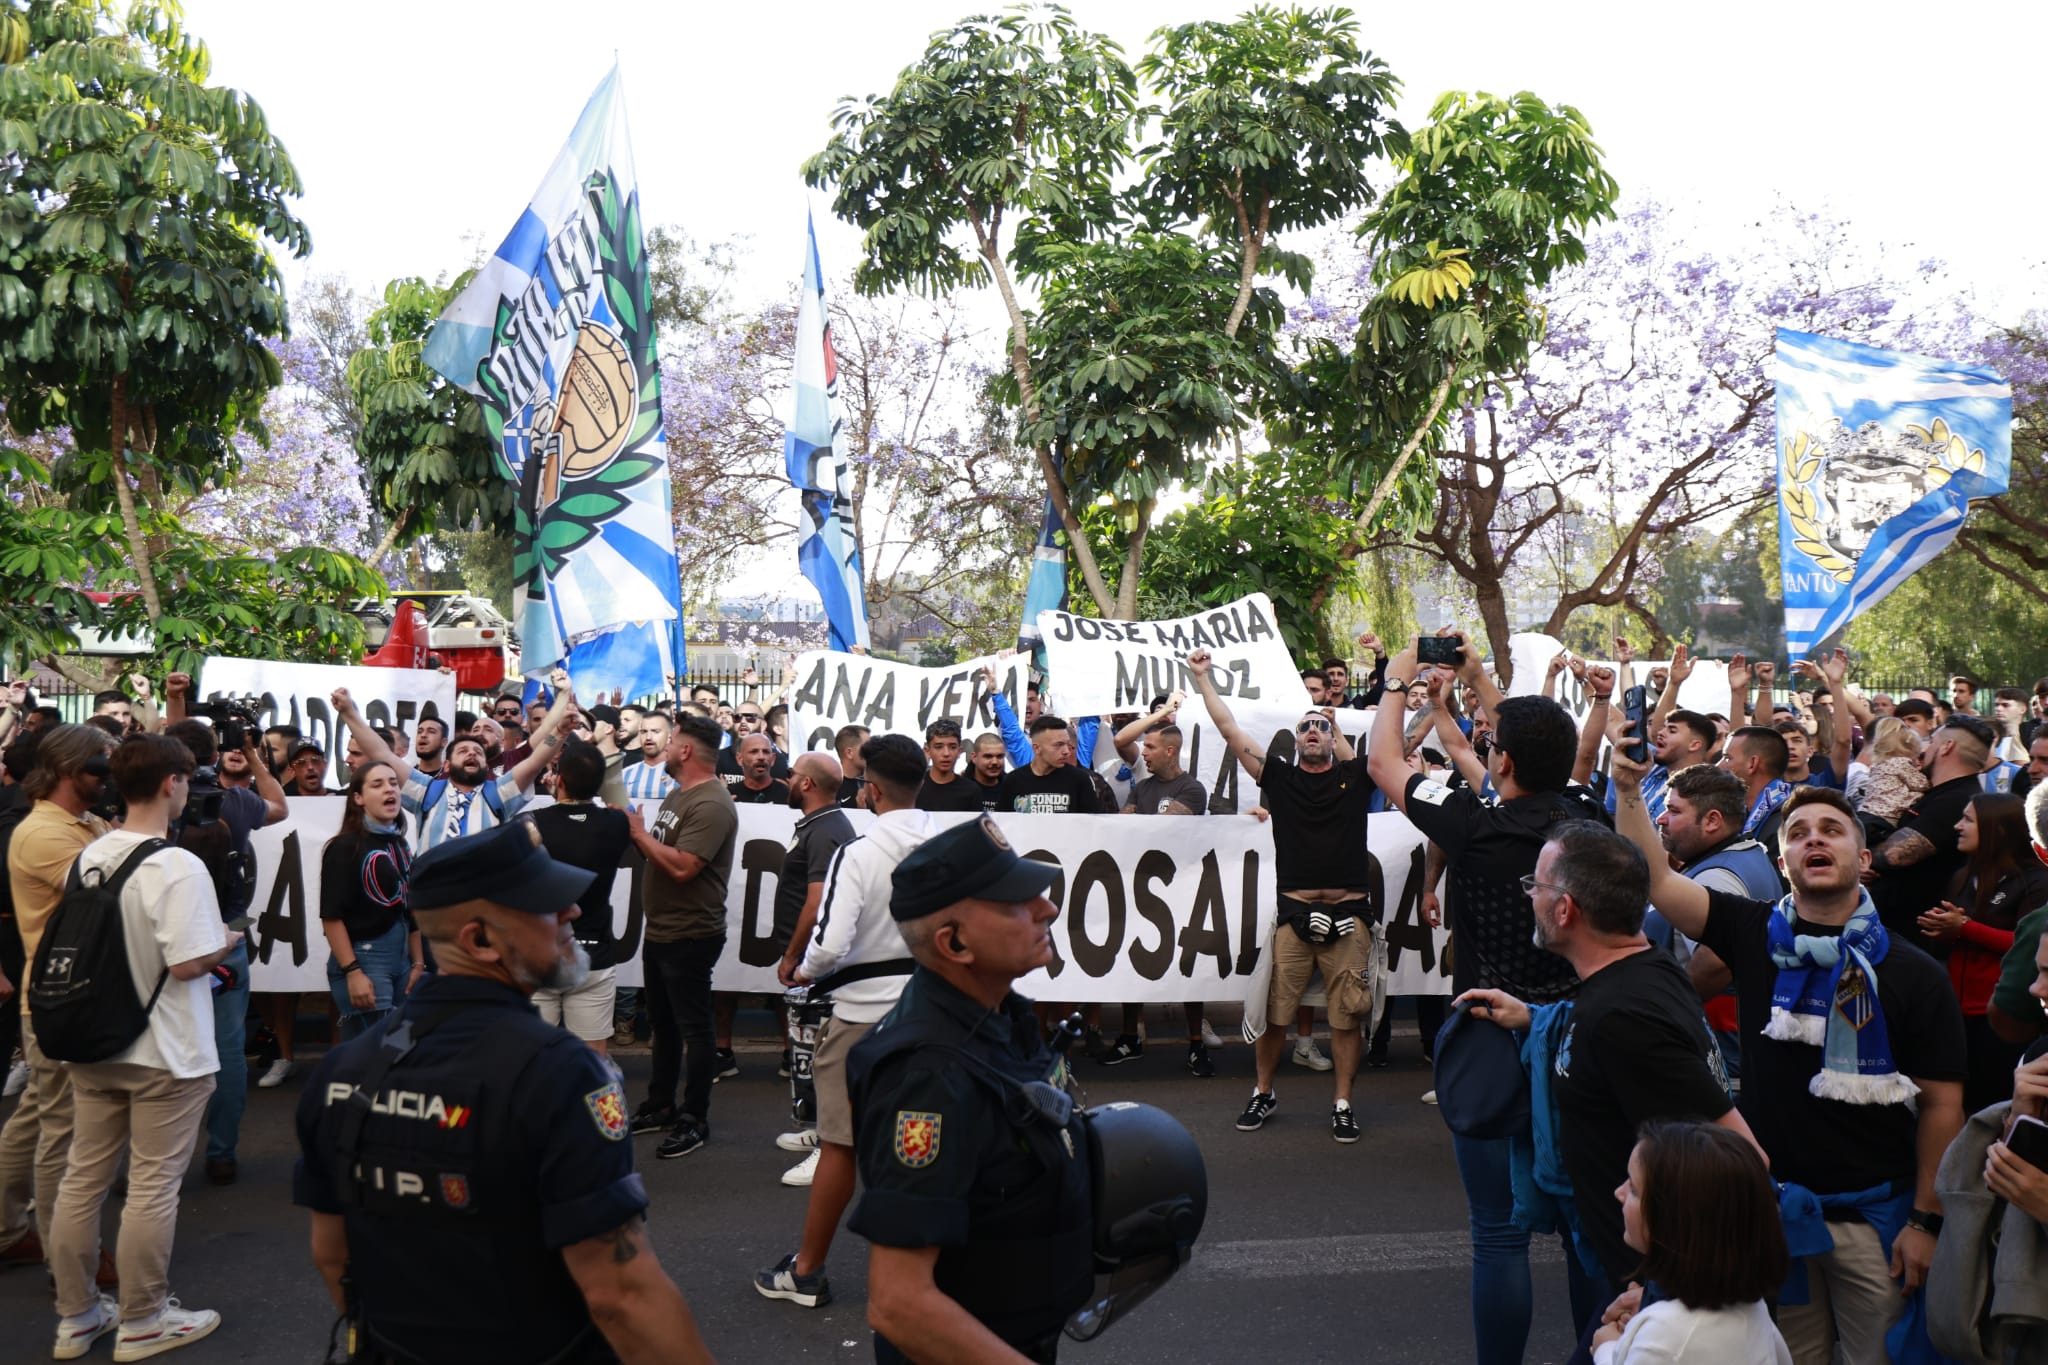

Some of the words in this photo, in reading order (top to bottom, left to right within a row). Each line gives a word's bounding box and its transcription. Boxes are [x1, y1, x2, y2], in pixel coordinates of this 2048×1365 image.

[1054, 613, 1149, 644] JOSE
[1153, 600, 1275, 651] MARIA
[795, 658, 895, 731] ANA
[918, 665, 1019, 732] VERA
[1029, 794, 1069, 805] FONDO
[326, 1082, 448, 1122] PLICIA
